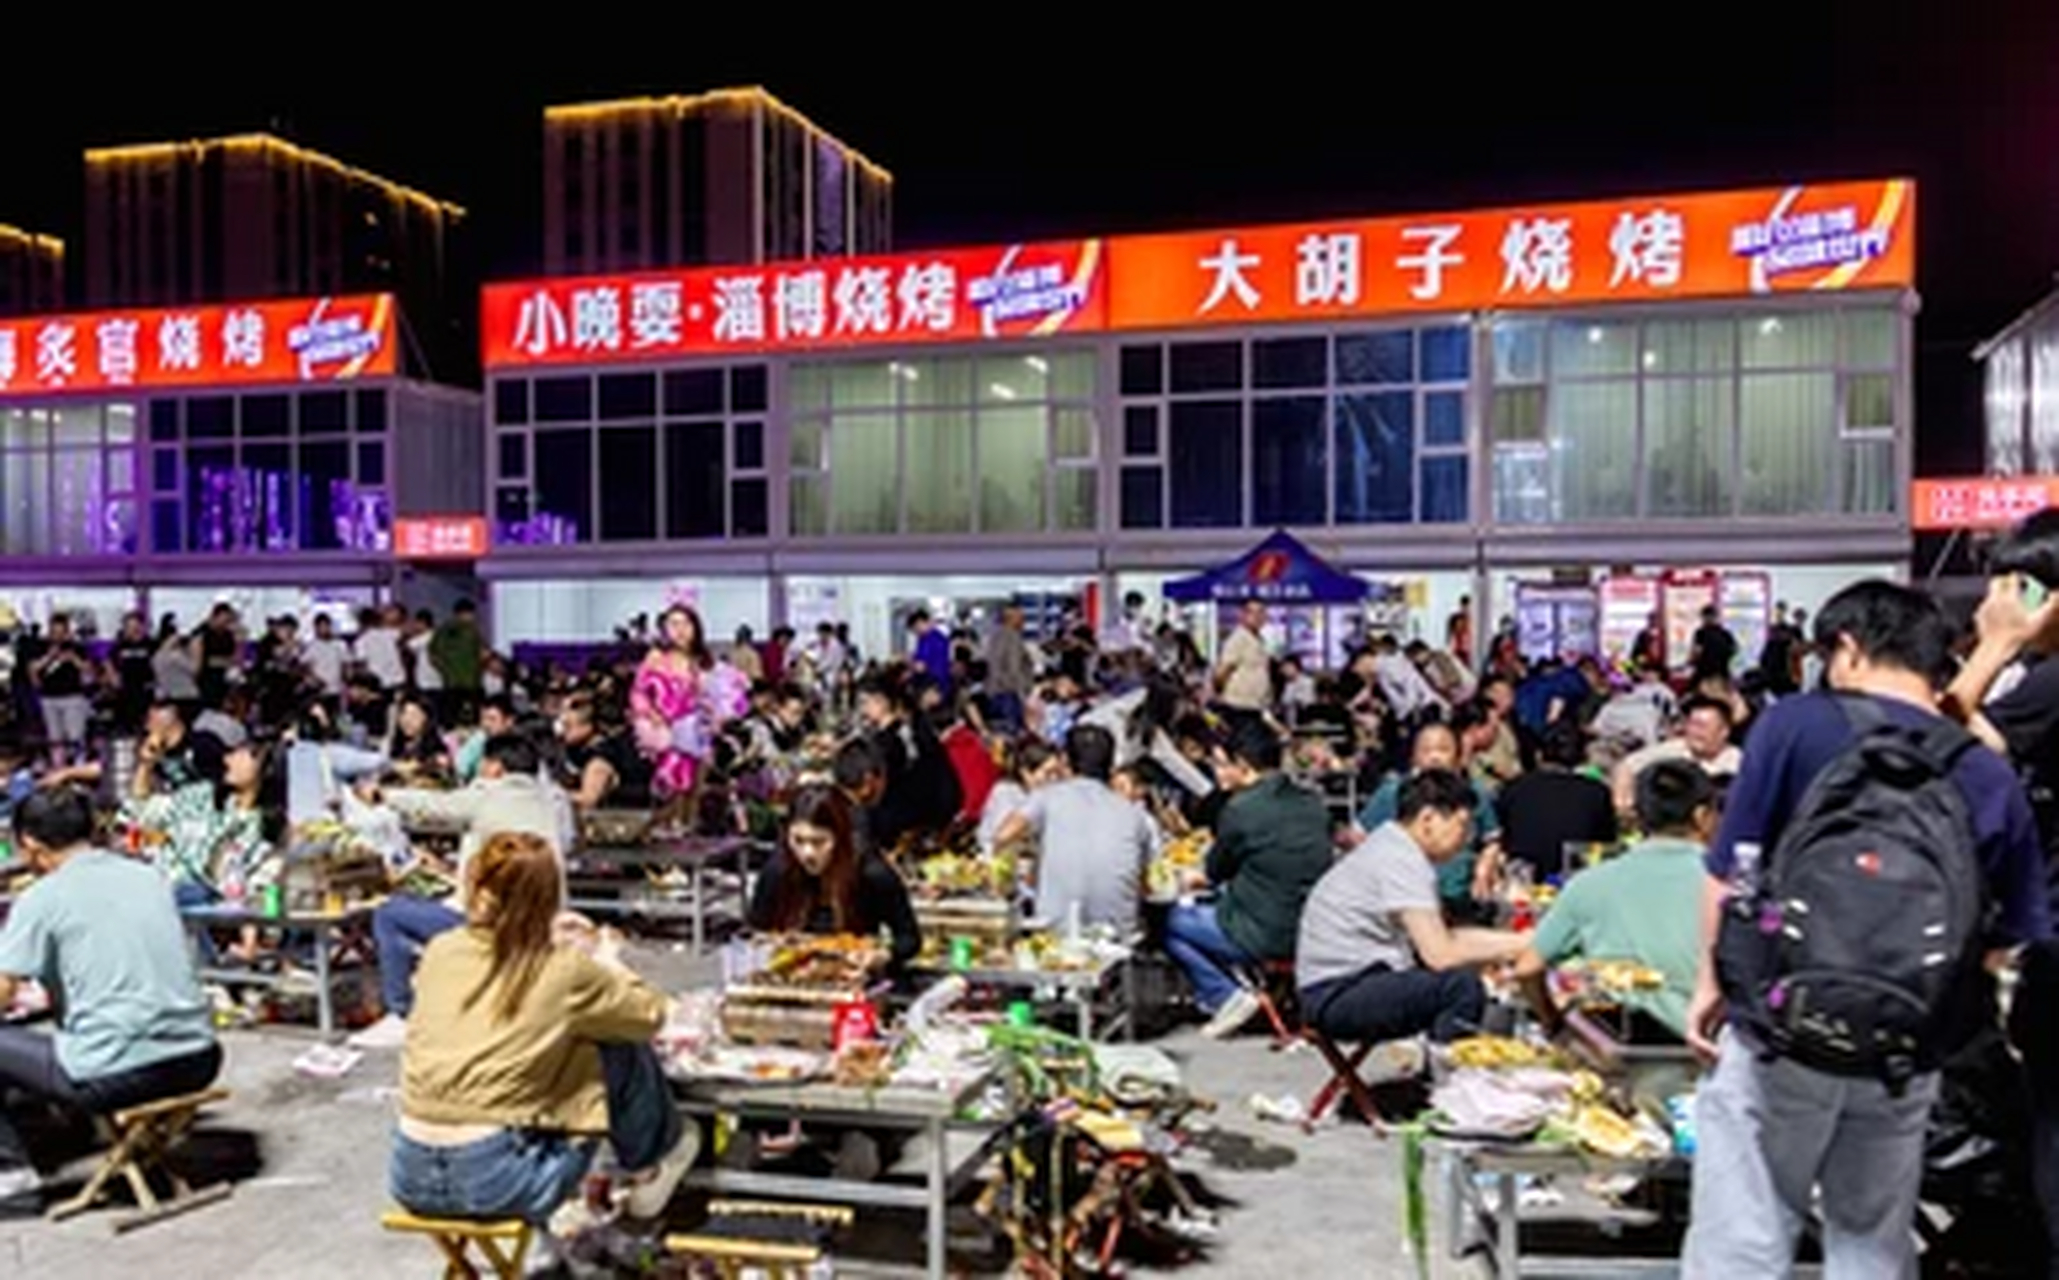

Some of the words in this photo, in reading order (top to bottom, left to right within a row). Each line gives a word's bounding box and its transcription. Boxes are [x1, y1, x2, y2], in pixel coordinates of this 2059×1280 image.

[1199, 209, 1685, 311] 大胡子烧烤
